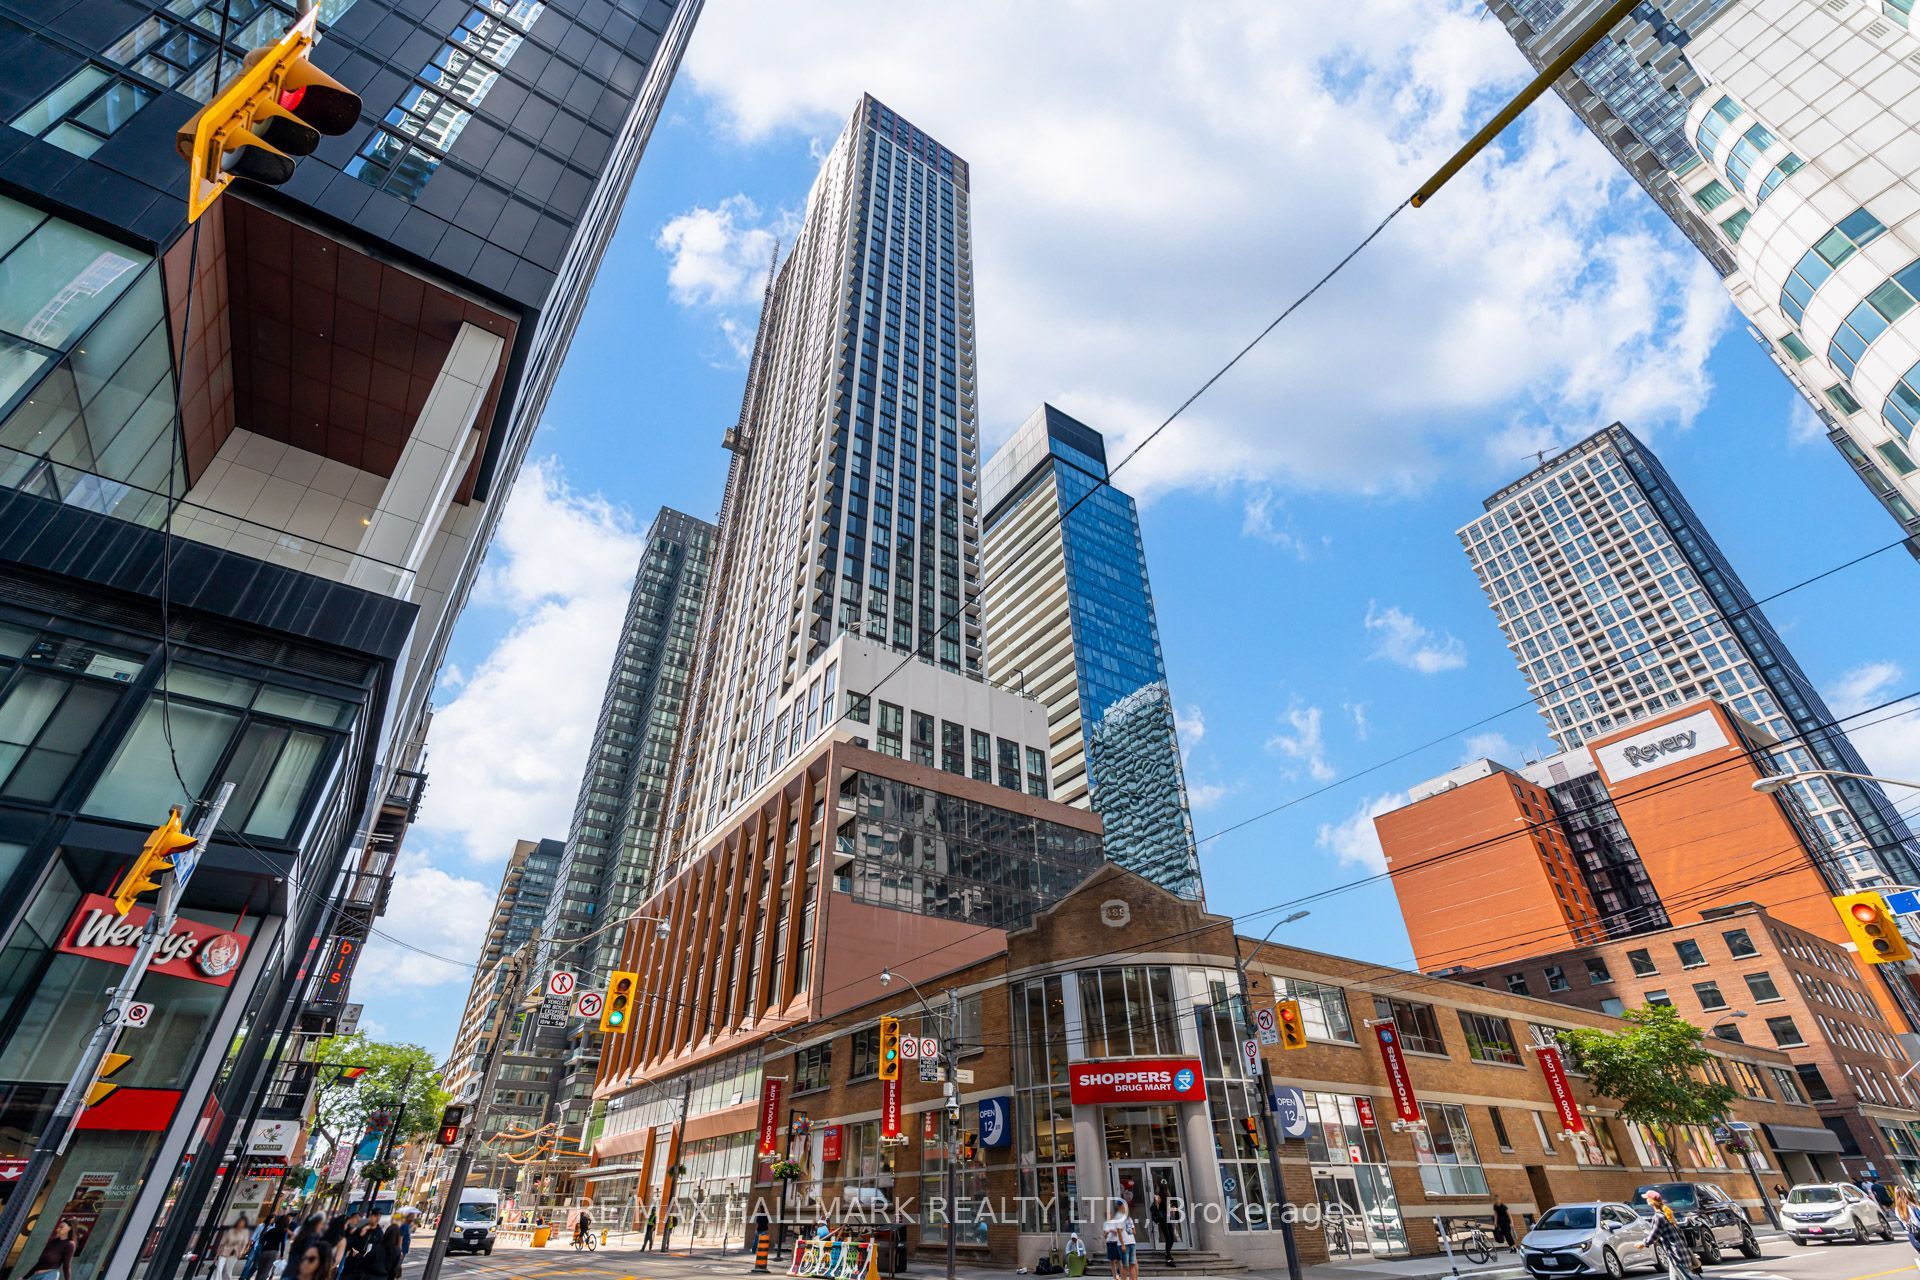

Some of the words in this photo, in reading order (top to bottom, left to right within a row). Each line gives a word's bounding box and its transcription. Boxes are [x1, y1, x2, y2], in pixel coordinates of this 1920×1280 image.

[1623, 729, 1696, 767] Revery
[76, 908, 198, 965] Weny's
[1544, 1054, 1556, 1073] LOVE
[1079, 1071, 1171, 1087] SHOPPERS
[1387, 1046, 1411, 1115] SHOPPERS
[1115, 1084, 1142, 1092] DRUG
[1144, 1083, 1171, 1092] MART
[888, 1080, 896, 1131] SHOPPE
[1277, 1097, 1296, 1106] OPEN
[980, 1109, 995, 1119] OPEN
[1284, 1110, 1296, 1121] 12
[1561, 1100, 1574, 1121] FOOD
[984, 1120, 994, 1132] 12
[446, 1128, 454, 1142] 4
